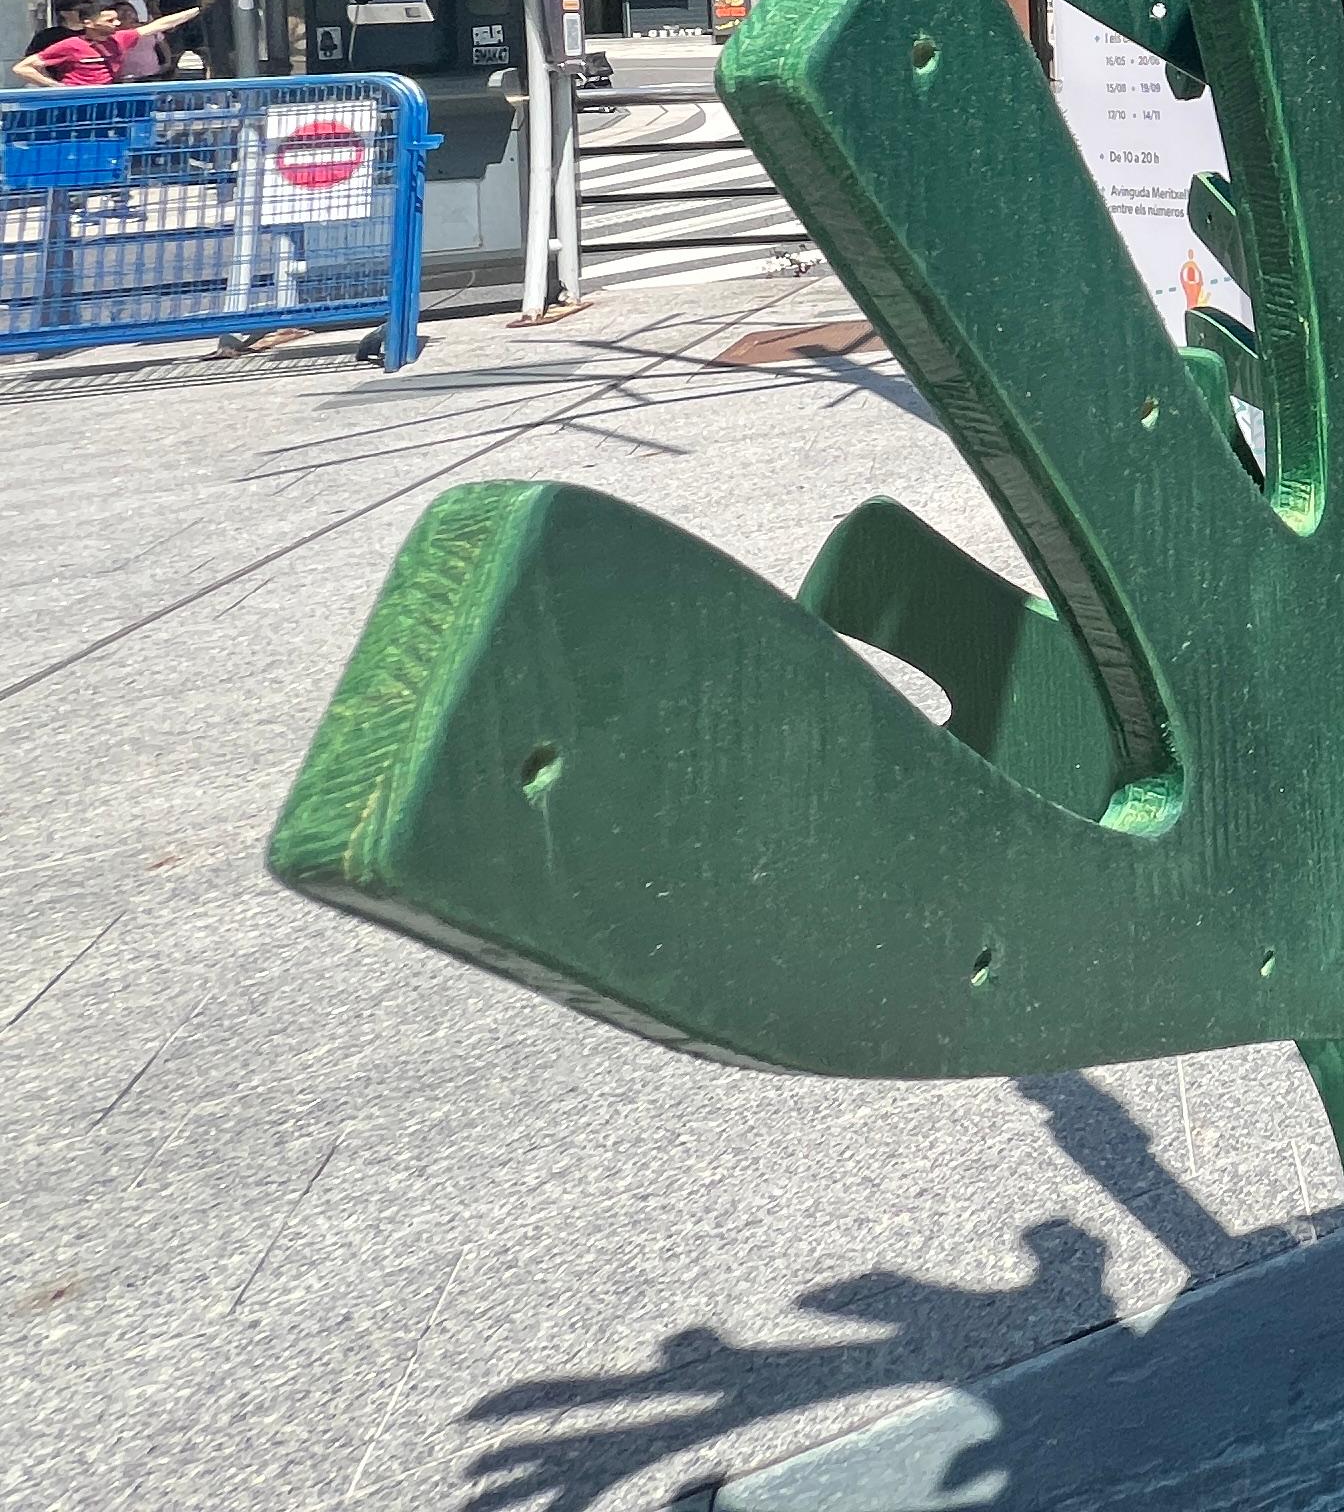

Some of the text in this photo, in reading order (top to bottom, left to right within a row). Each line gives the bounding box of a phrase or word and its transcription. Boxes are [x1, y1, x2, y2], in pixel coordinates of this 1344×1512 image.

[1109, 151, 1121, 163] De
[1123, 151, 1133, 163] 10
[1134, 154, 1140, 163] a
[1141, 152, 1153, 163] 20
[1110, 185, 1150, 200] Avinguda
